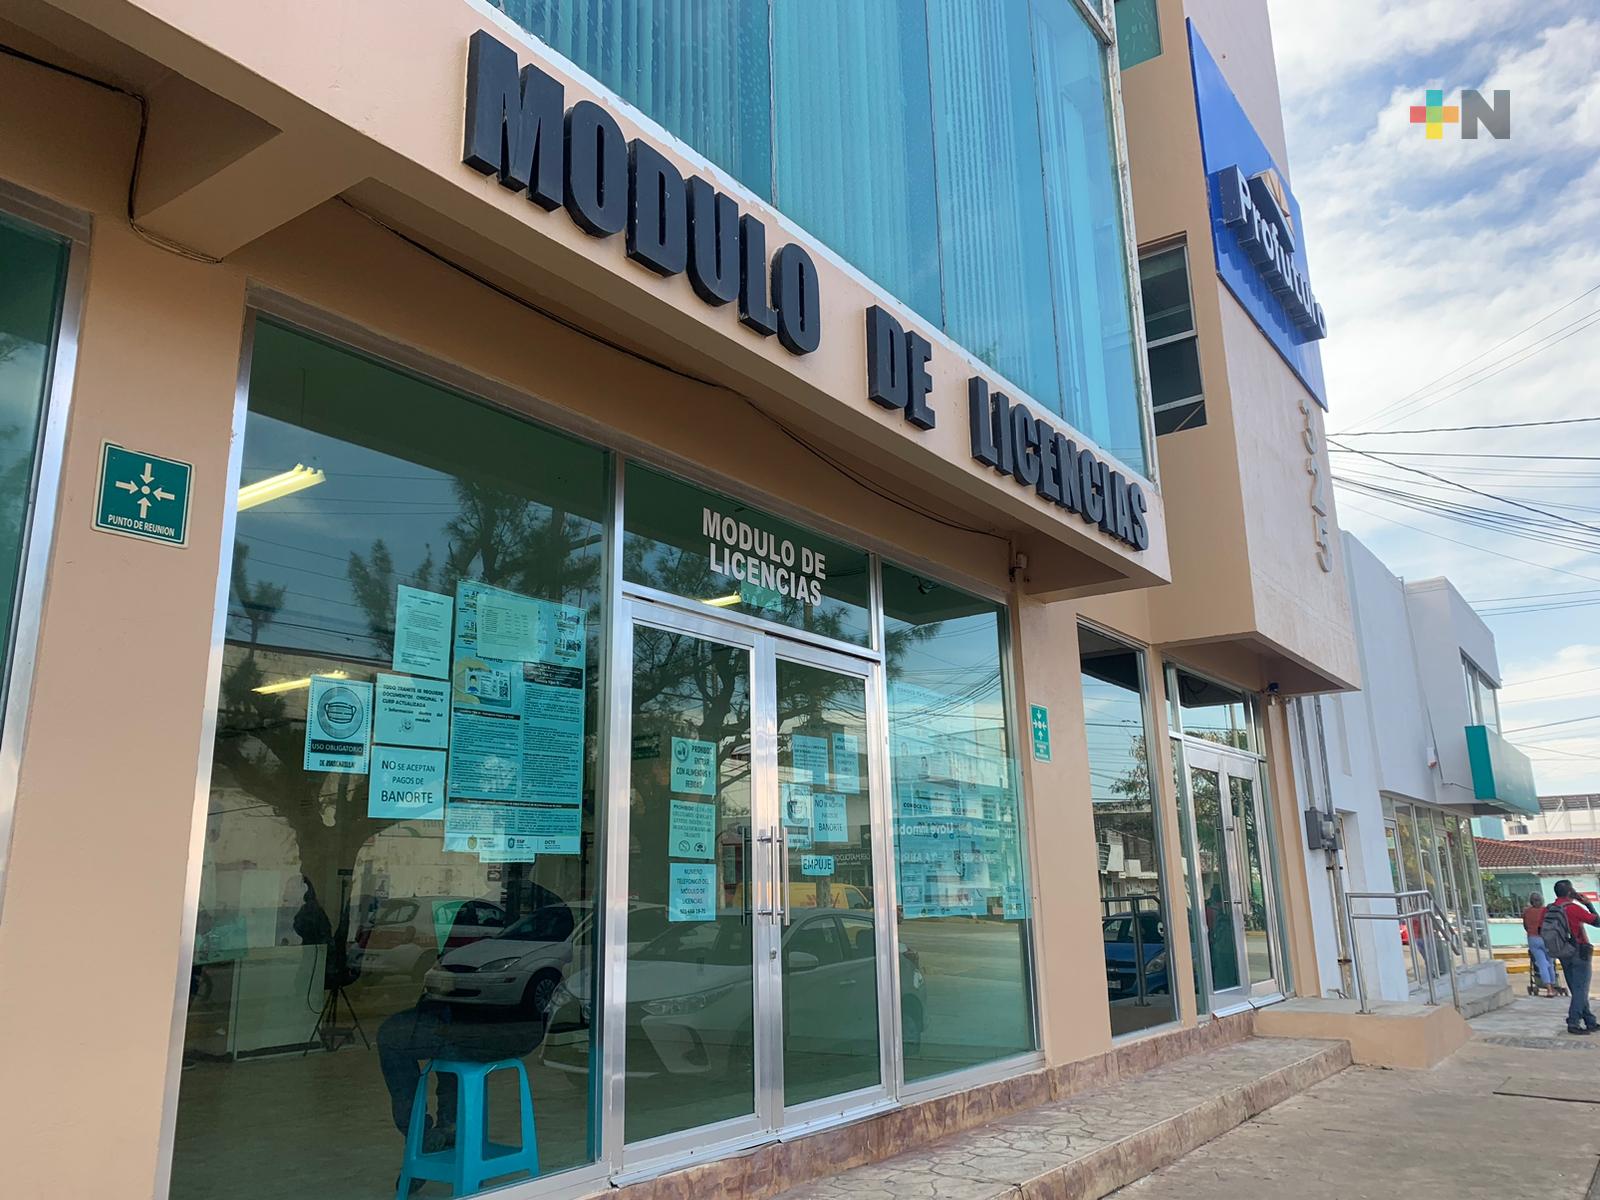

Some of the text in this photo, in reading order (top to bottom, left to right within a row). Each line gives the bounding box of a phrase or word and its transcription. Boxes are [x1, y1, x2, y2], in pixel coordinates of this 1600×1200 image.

[1220, 164, 1328, 340] Profuturo
[463, 29, 1150, 551] MODULO DE LICENCIAS
[107, 514, 175, 537] PUNTO DE REUNION
[703, 507, 827, 580] MODULO DE
[710, 542, 822, 607] LICENCIAS
[325, 744, 363, 753] OBLIGATORIO
[381, 760, 436, 773] NO SE ACEPTAN
[392, 776, 424, 785] PAGOS DE
[381, 790, 433, 804] BANORTE
[815, 799, 824, 808] NO
[818, 822, 843, 832] BANORTE
[802, 857, 832, 871] EMPUJE
